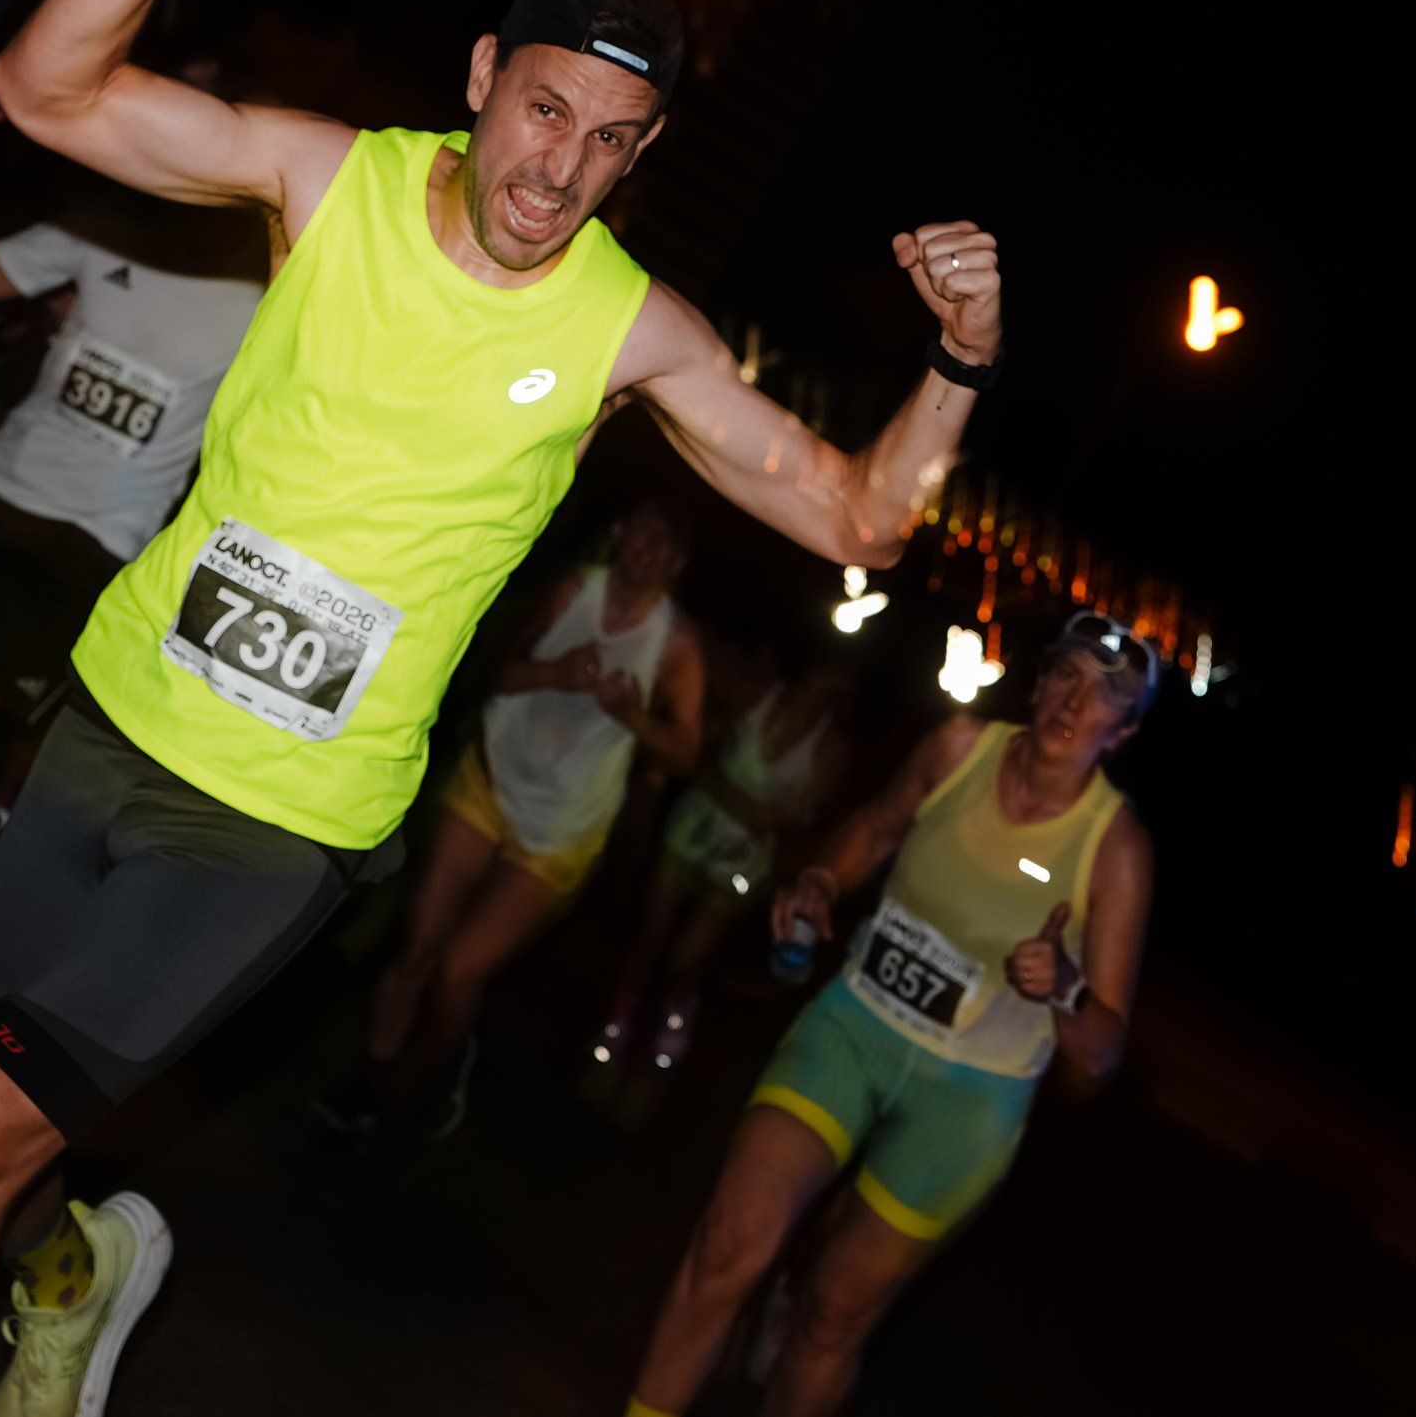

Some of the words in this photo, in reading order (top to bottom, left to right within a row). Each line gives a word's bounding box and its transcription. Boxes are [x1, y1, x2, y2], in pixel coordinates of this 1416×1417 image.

[65, 369, 159, 439] 3916
[215, 536, 290, 587] LANOCT.
[203, 586, 328, 690] 730
[877, 948, 948, 1009] 657
